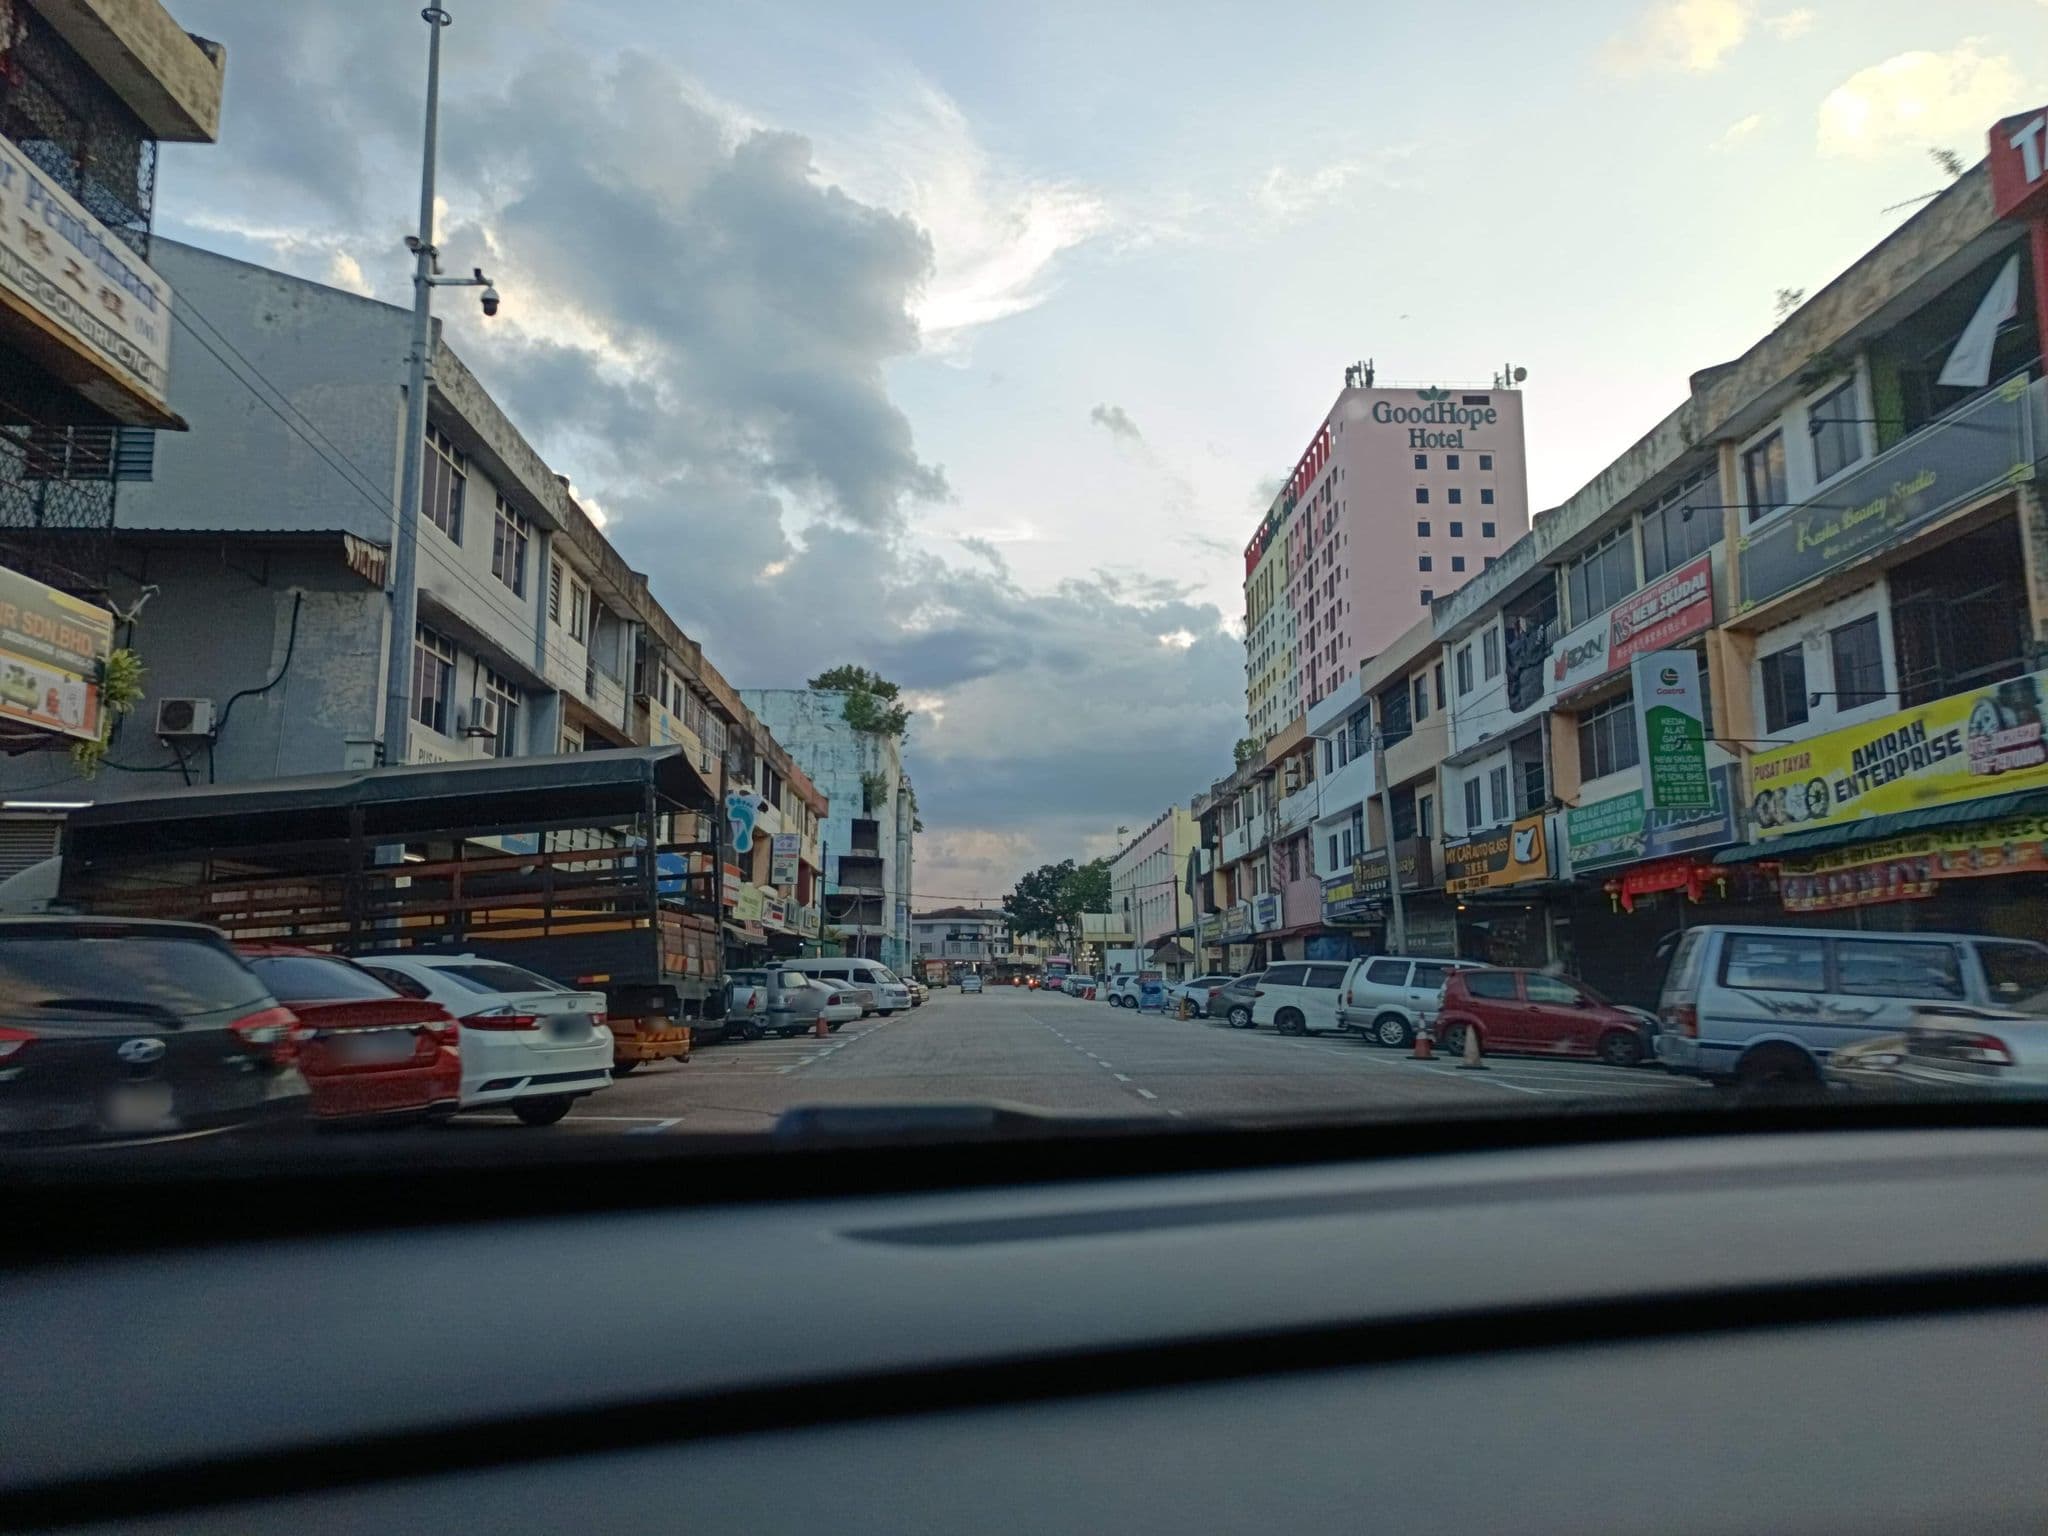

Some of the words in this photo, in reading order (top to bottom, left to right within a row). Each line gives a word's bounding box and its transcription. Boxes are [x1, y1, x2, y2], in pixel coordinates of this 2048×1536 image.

[2009, 113, 2048, 184] T
[38, 282, 162, 388] CONSTRUCTION
[1372, 401, 1497, 430] GoodHope
[1408, 428, 1464, 449] Hotel
[1632, 599, 1658, 625] NEW
[1659, 571, 1707, 609] SKUDAI
[1656, 687, 1686, 695] Castrol
[1660, 717, 1686, 726] KEDAI
[1663, 726, 1686, 734] ALAT
[1851, 719, 1927, 773] AMIRAH
[1753, 760, 1781, 781] PUSAT
[1782, 751, 1811, 774] TAYAR
[1834, 728, 1964, 803] ENTERPRISE
[1457, 844, 1472, 862] CAR
[1488, 837, 1508, 855] GLASS
